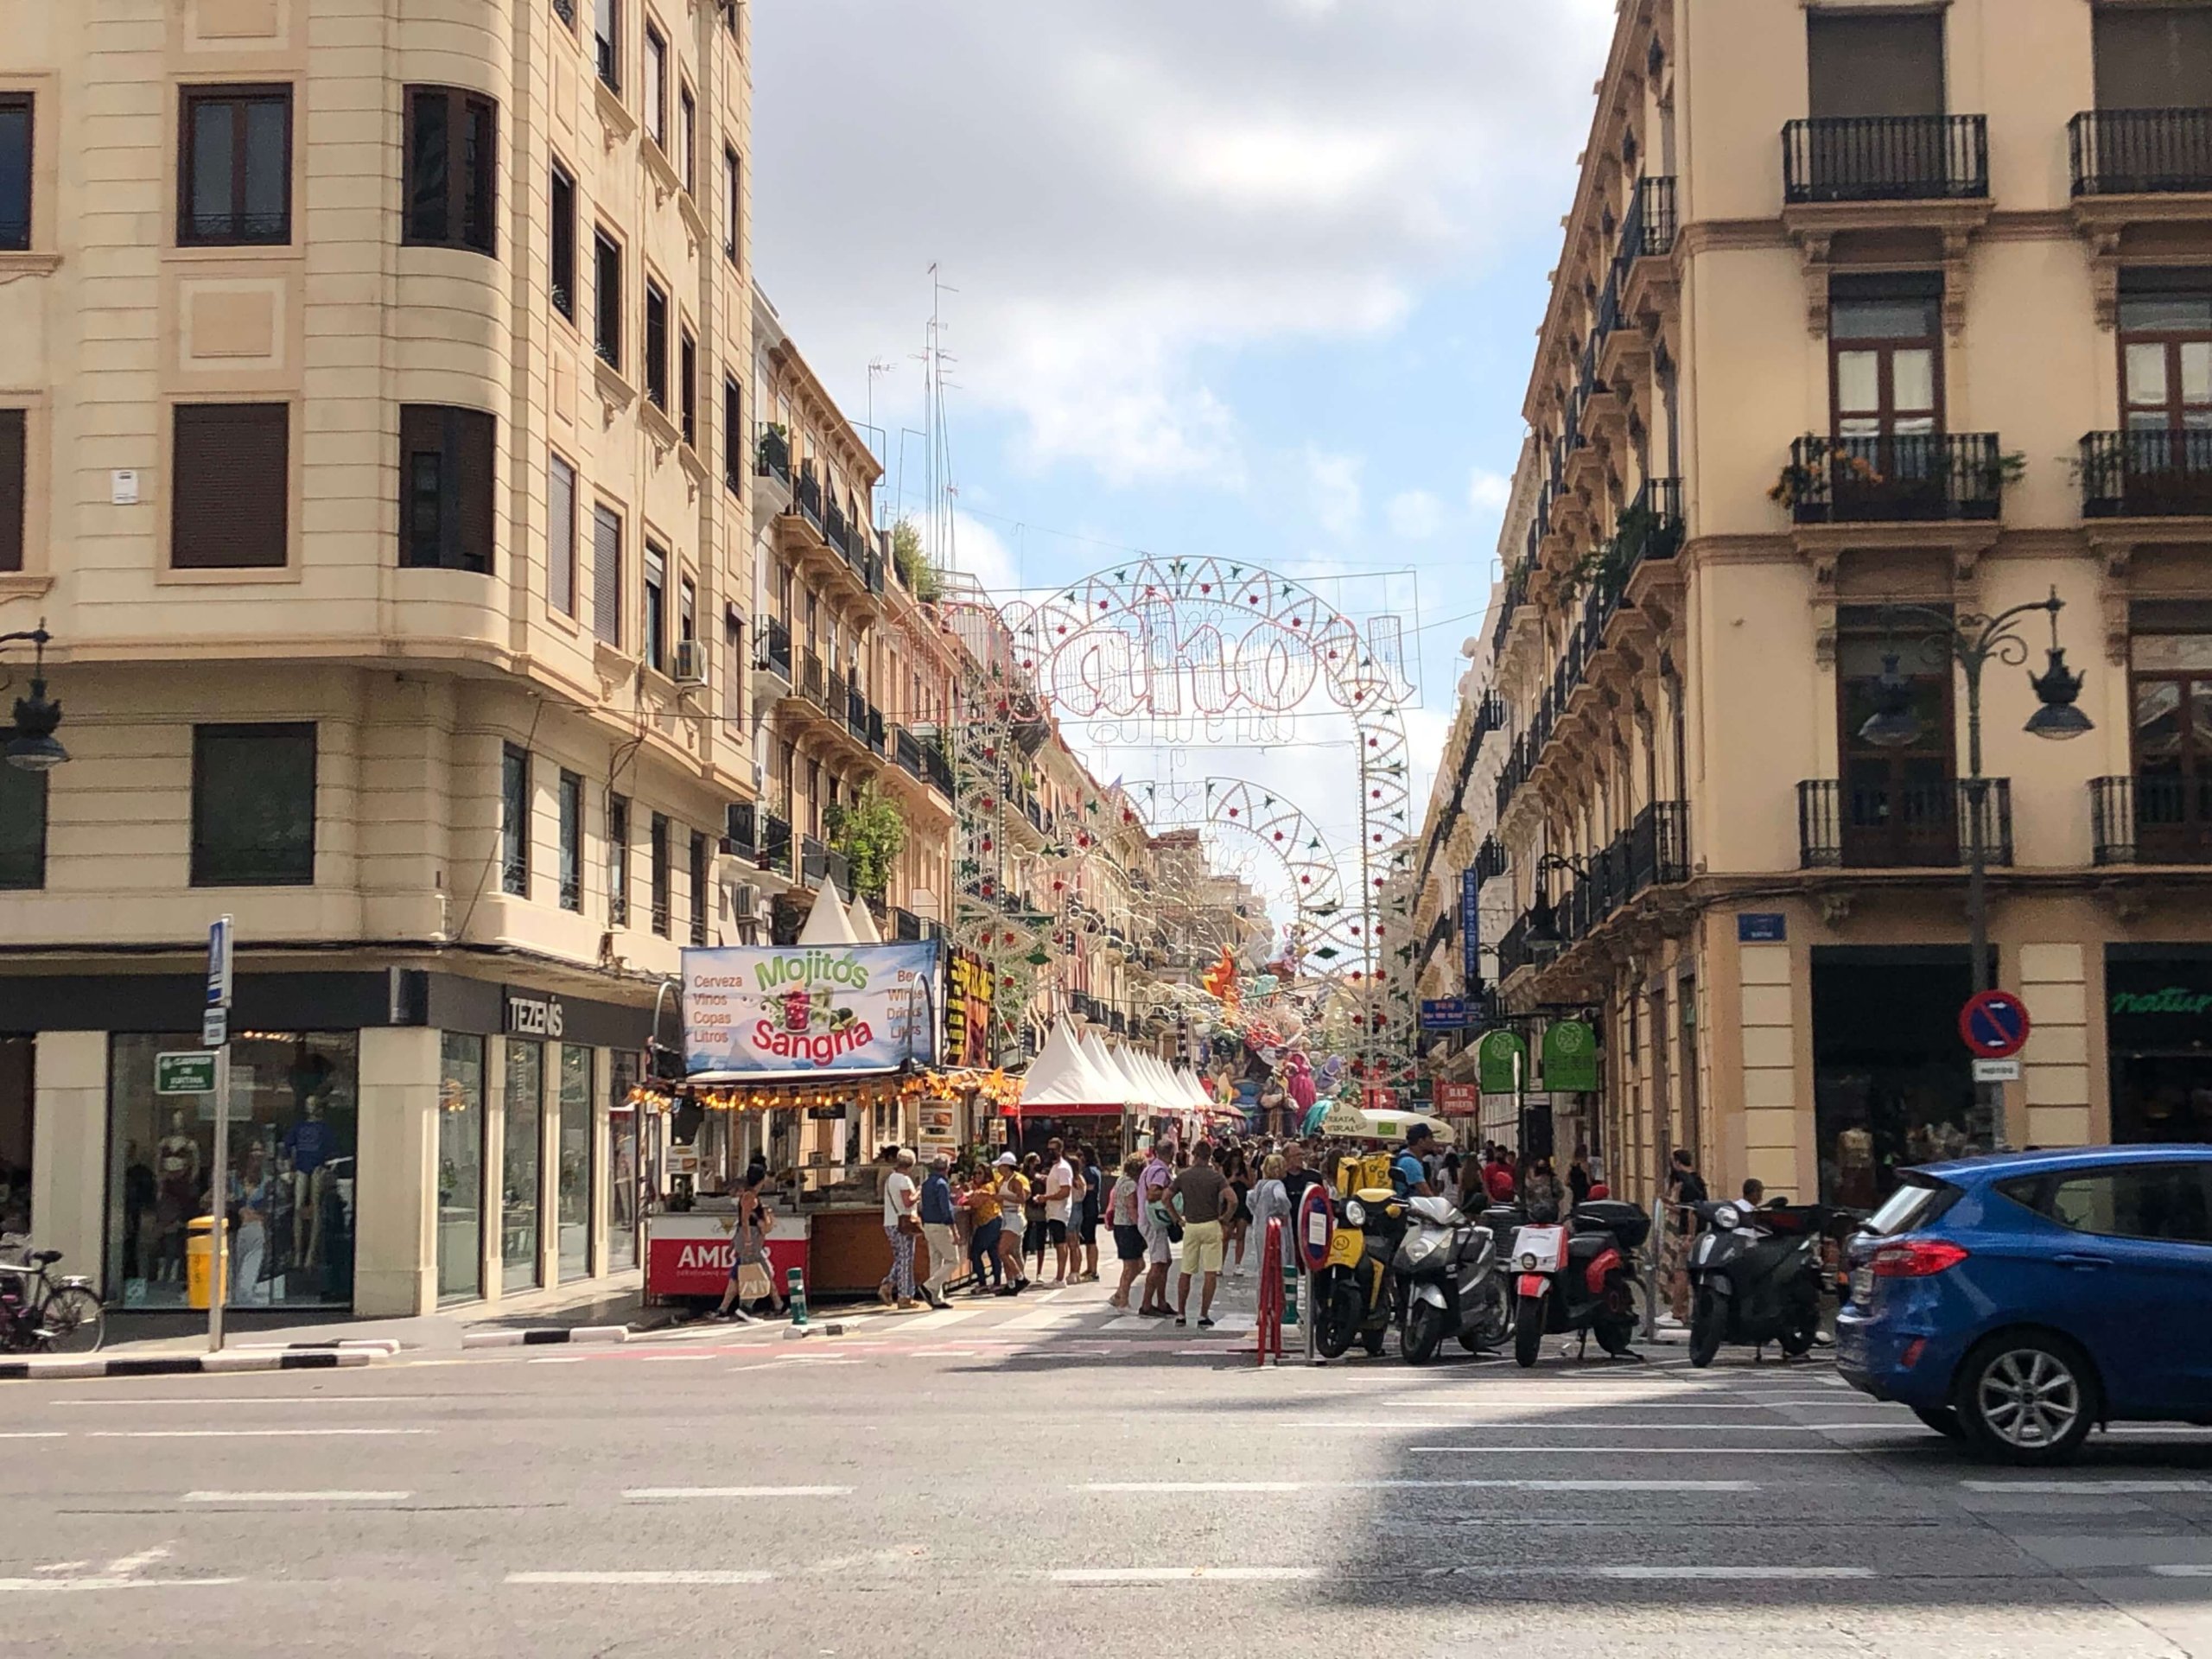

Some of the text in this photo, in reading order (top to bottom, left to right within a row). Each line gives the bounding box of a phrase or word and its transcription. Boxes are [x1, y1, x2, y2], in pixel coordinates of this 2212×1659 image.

[753, 950, 869, 992] Mojitos
[694, 975, 743, 988] Cerveza
[693, 993, 728, 1006] Vinos
[509, 995, 563, 1037] TEZENIS
[694, 1011, 732, 1027] Copas
[694, 1030, 729, 1043] Litros
[890, 1025, 921, 1039] Litrs
[752, 1019, 874, 1067] Sangria
[677, 1244, 772, 1269] AMB
